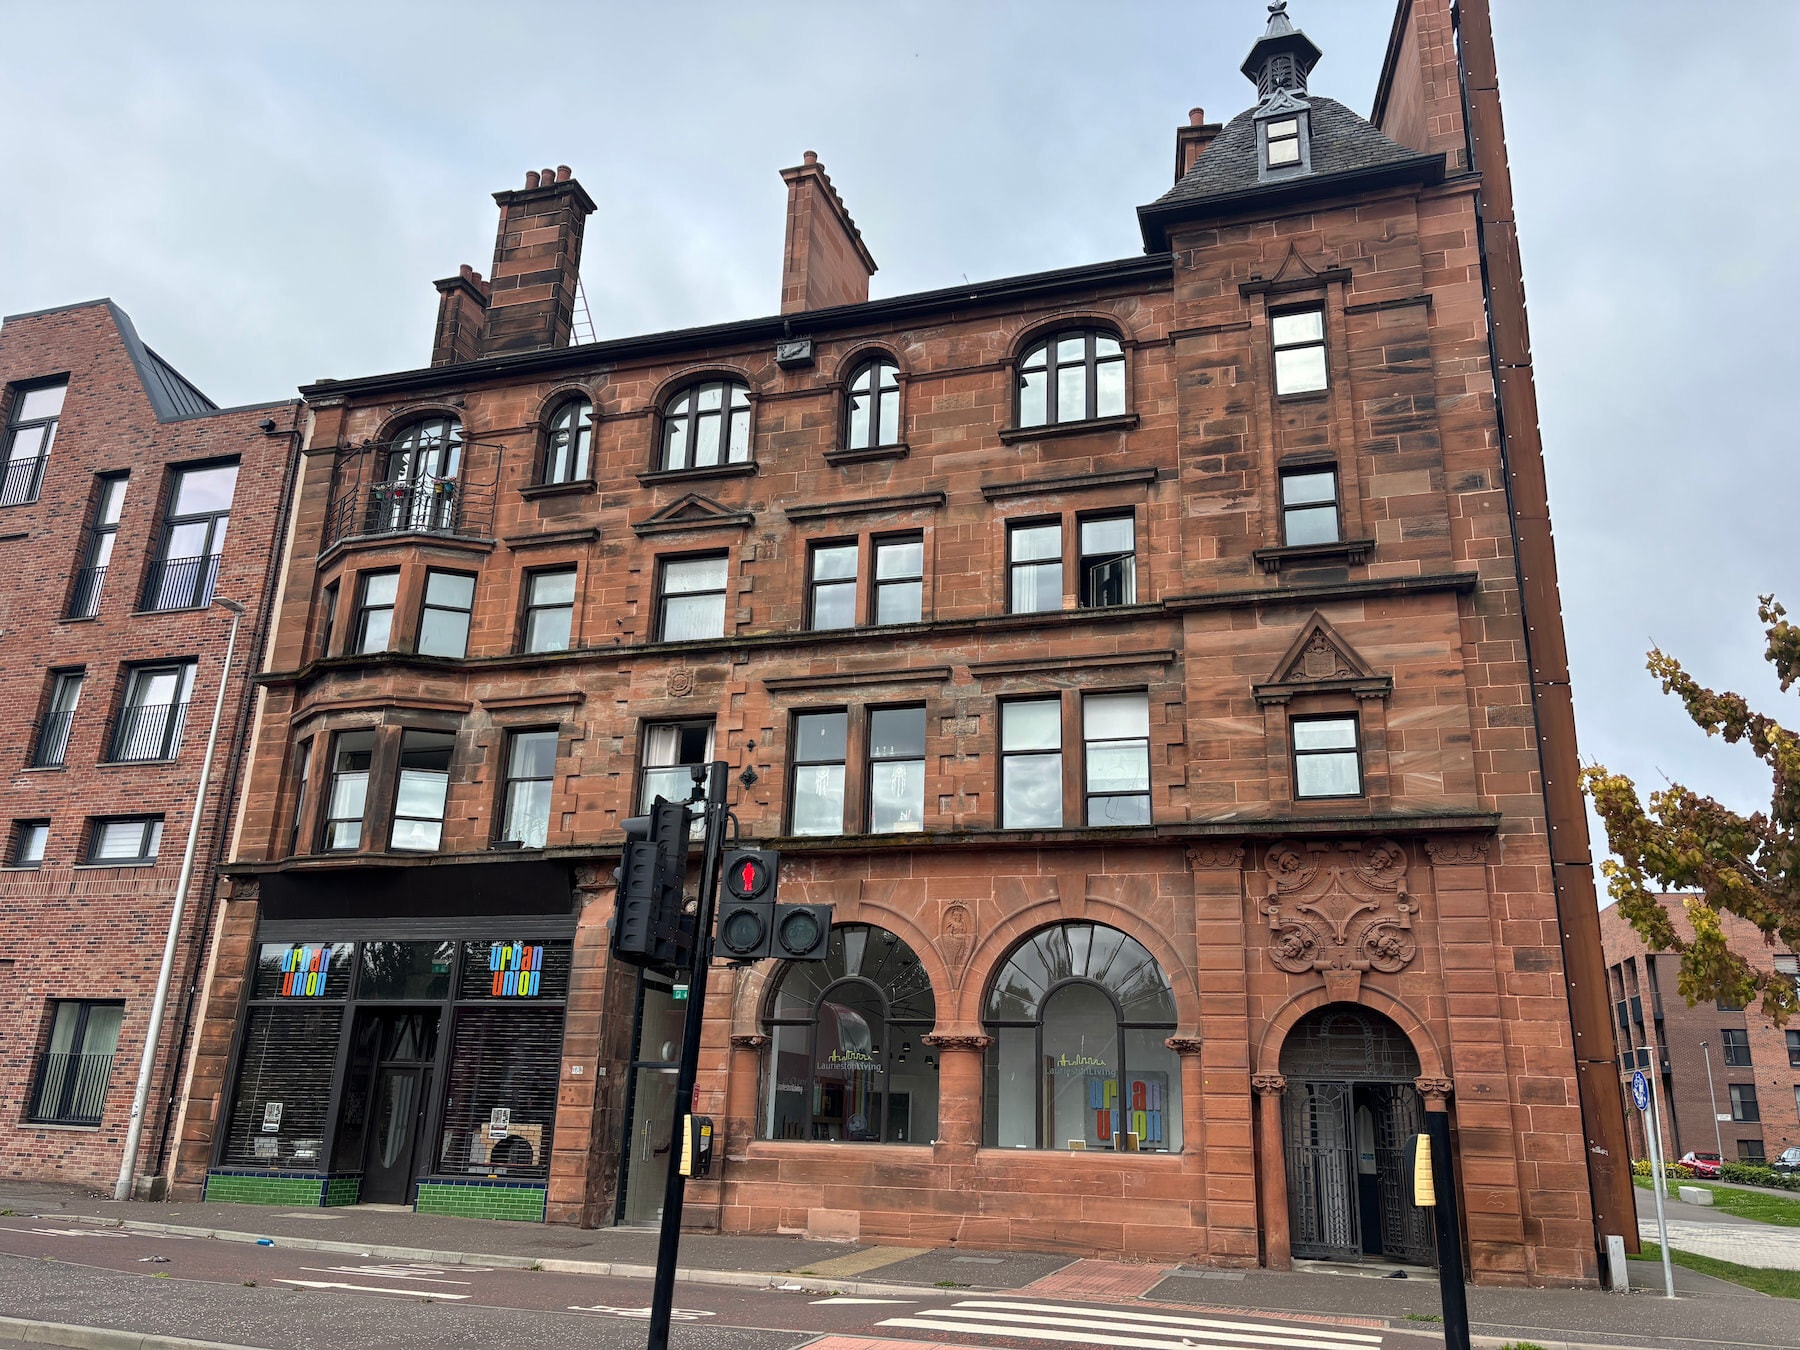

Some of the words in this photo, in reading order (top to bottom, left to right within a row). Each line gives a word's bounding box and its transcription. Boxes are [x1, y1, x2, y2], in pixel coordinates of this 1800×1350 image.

[281, 946, 331, 972] urban
[490, 943, 543, 971] urban
[282, 972, 327, 996] union
[492, 971, 540, 996] union
